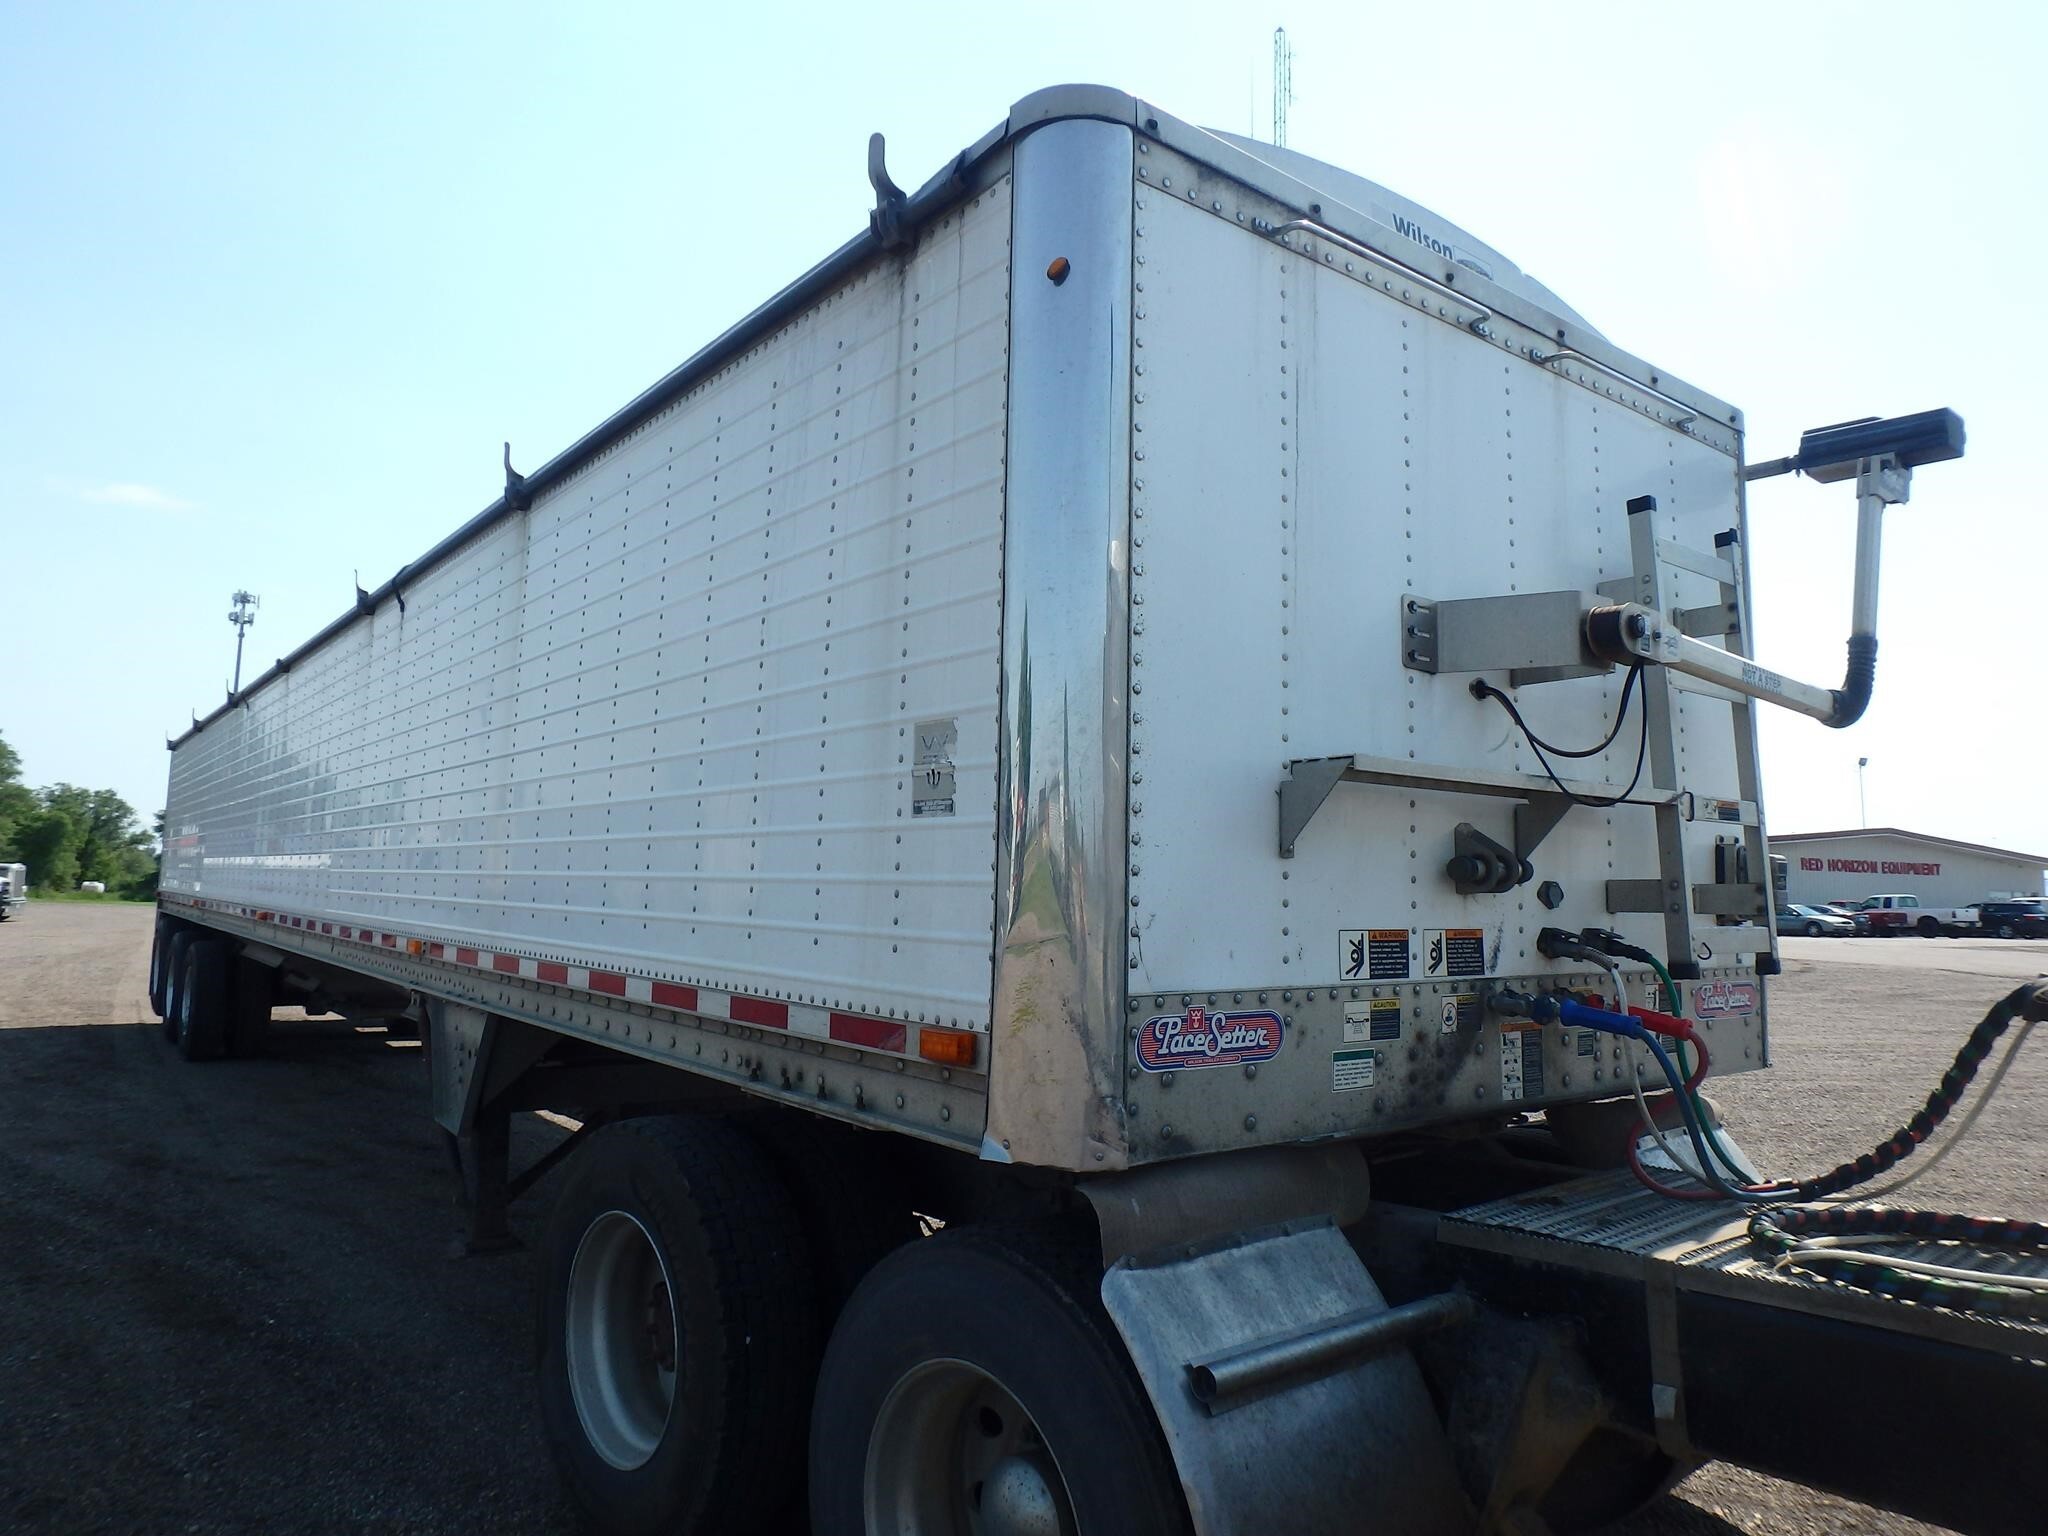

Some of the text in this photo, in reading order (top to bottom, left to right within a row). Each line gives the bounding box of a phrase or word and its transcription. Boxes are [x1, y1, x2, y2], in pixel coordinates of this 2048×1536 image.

[1392, 213, 1454, 260] Wilson
[1800, 857, 1941, 876] RED HORIZON EQUIPMENT
